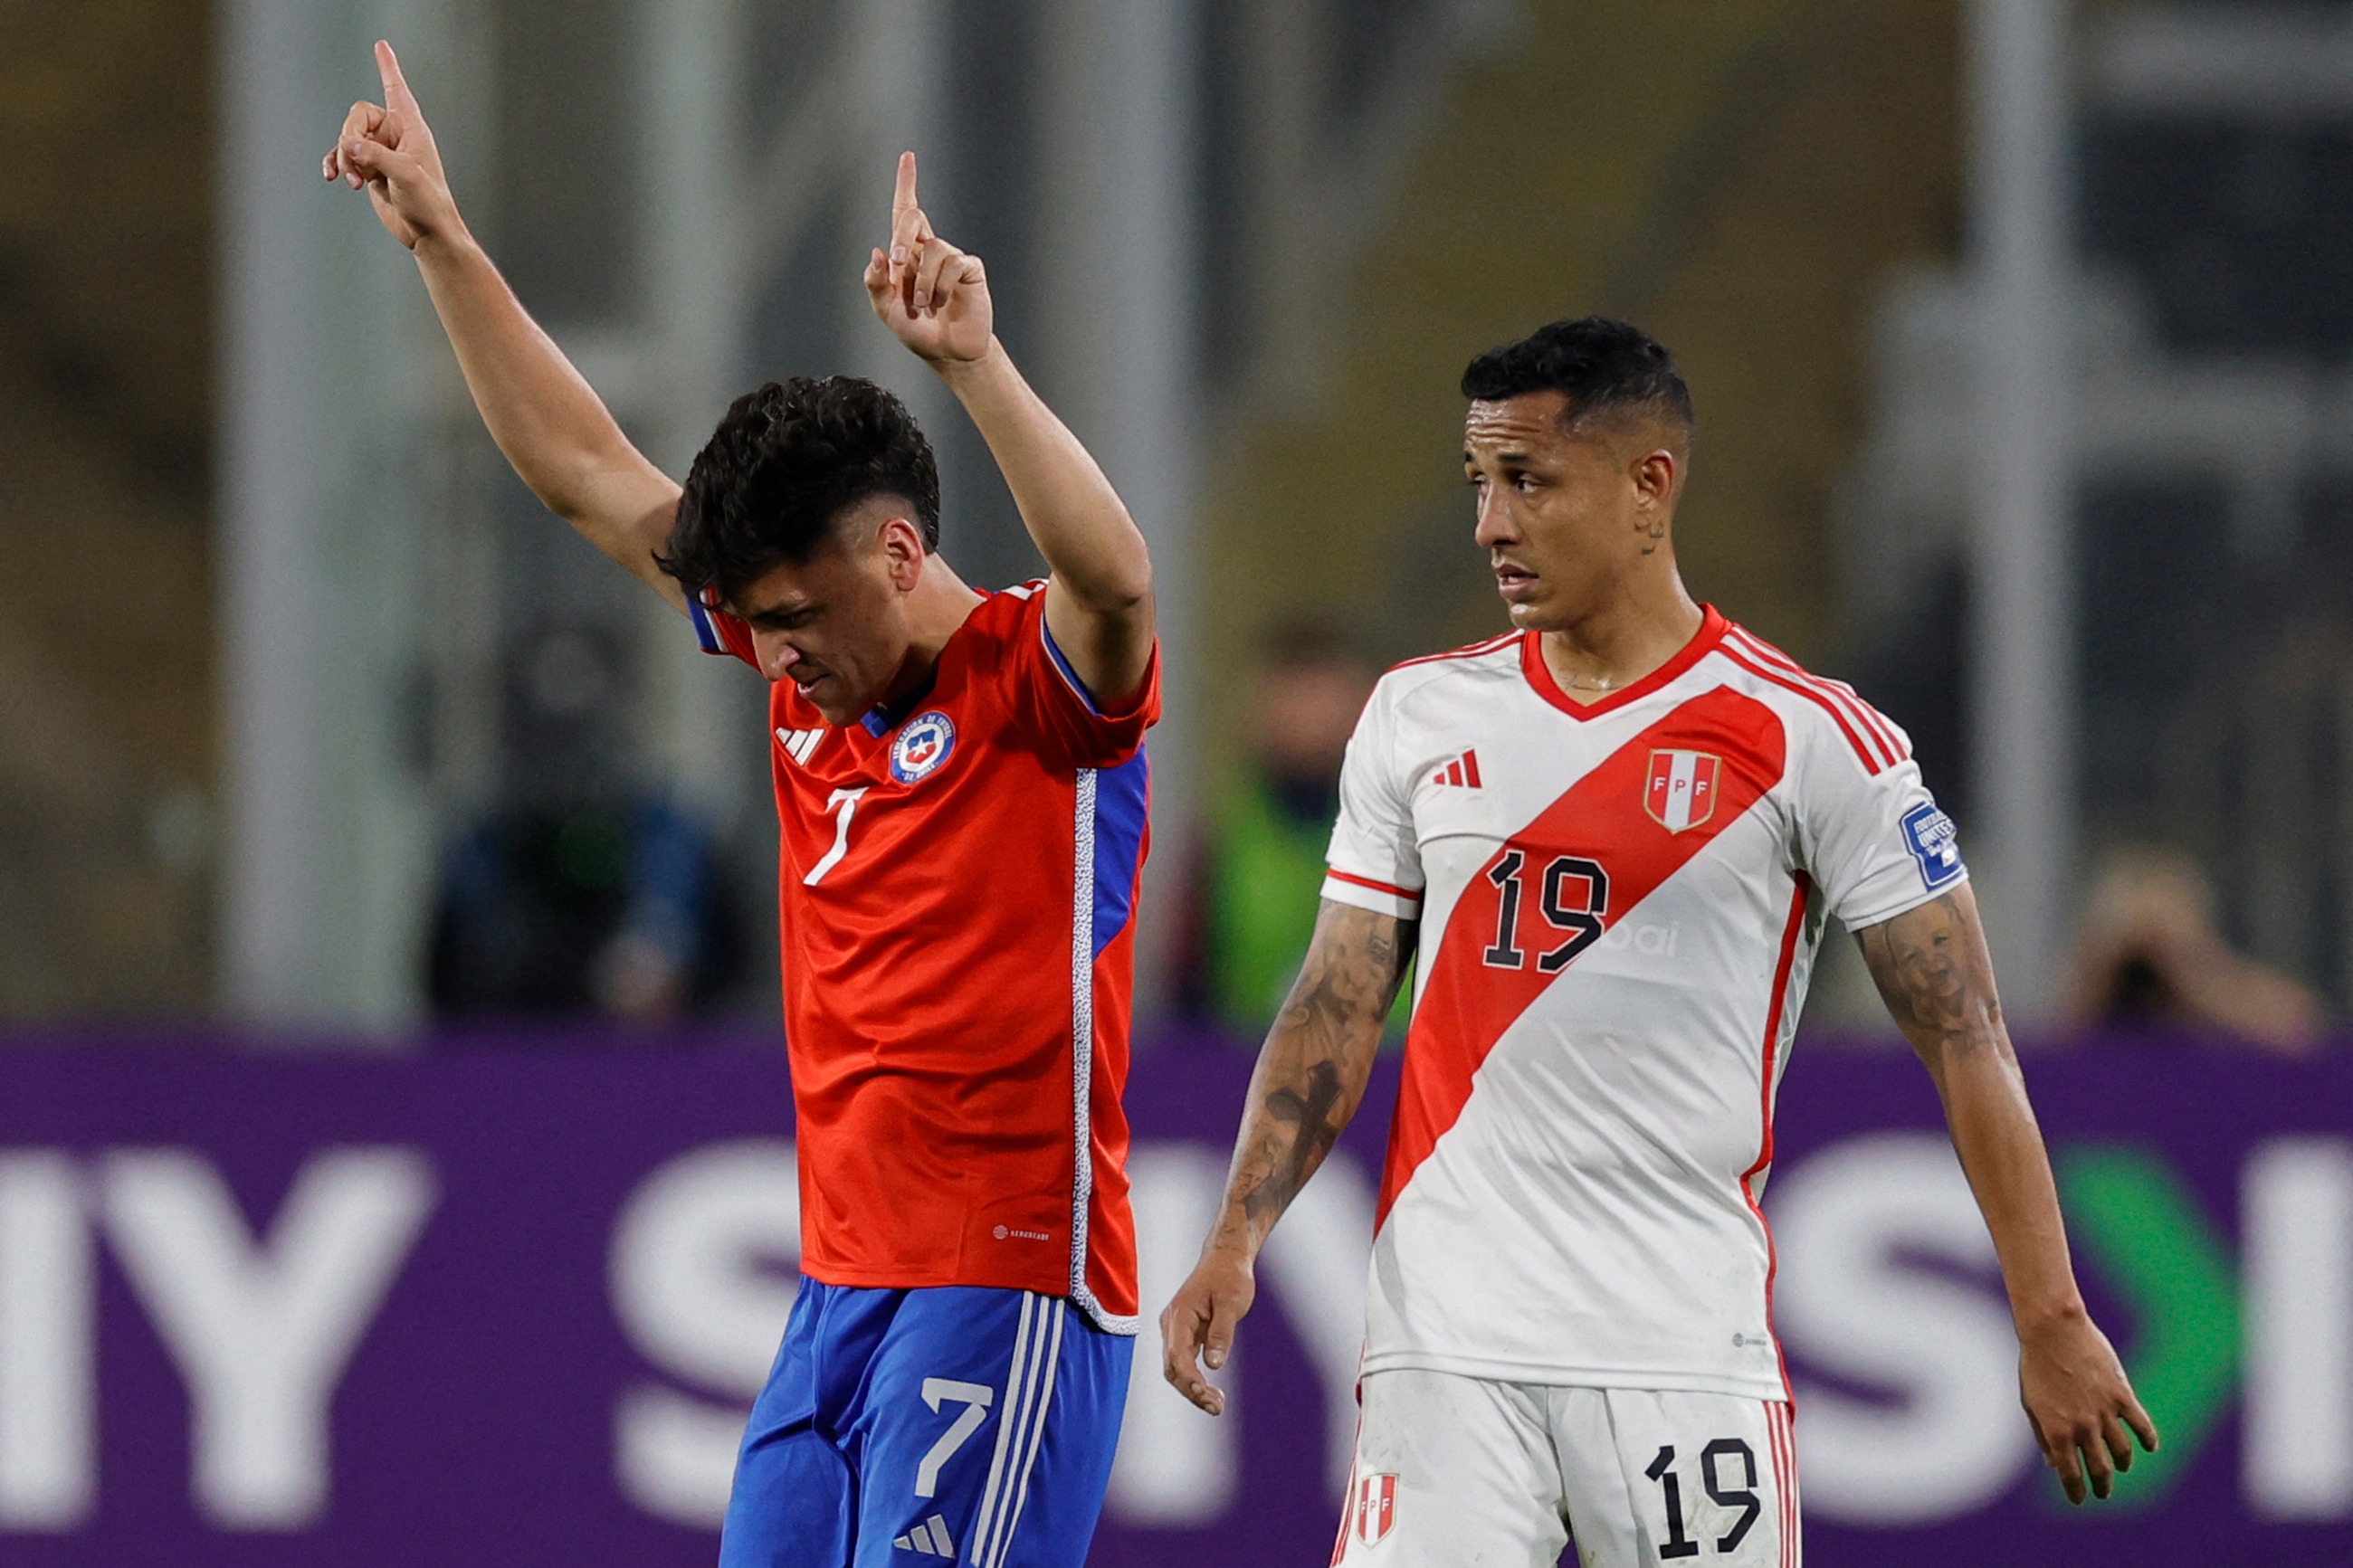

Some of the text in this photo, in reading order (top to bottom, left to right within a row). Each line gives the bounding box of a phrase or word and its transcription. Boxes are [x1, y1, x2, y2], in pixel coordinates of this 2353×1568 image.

[803, 786, 870, 886] 7
[1482, 850, 1609, 974] 19
[915, 1377, 994, 1498] 7
[1644, 1438, 1761, 1560] 19
